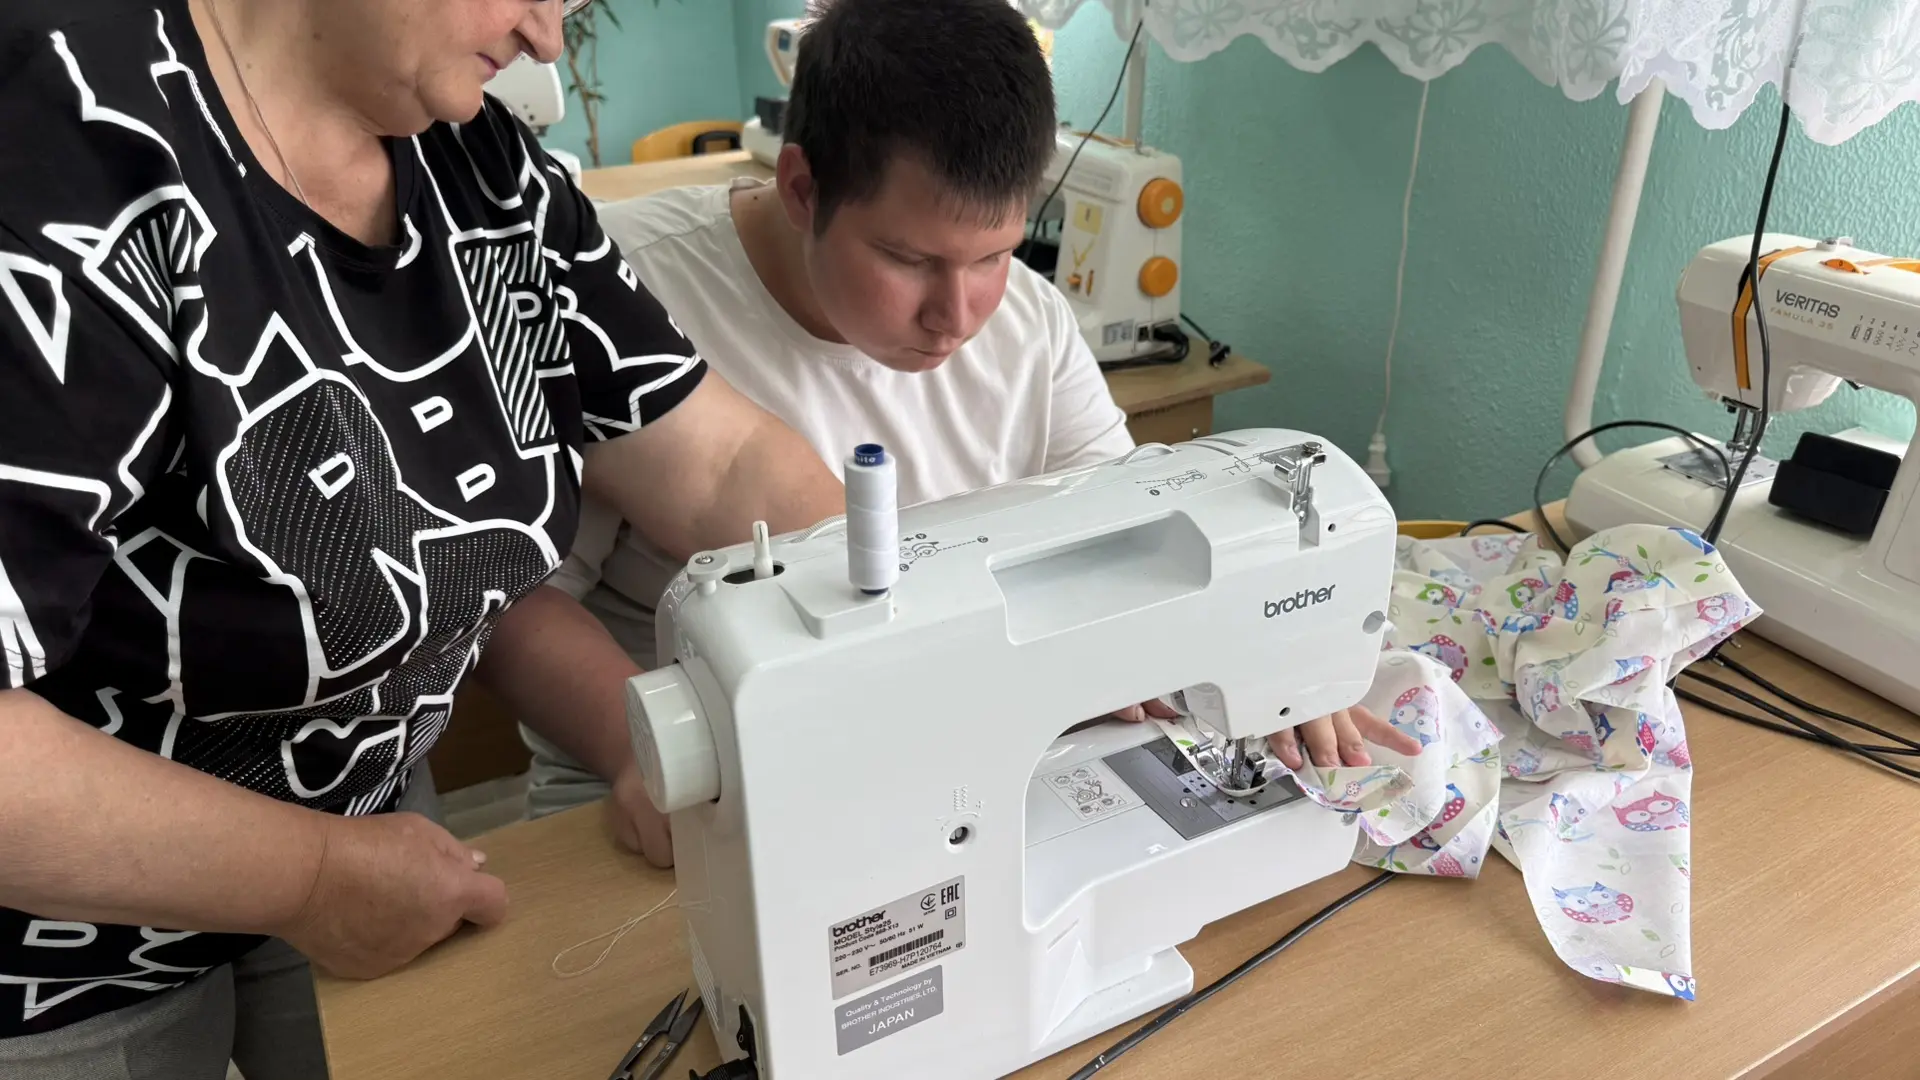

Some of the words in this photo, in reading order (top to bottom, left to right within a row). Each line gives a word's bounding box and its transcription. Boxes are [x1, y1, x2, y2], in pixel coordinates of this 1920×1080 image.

[1776, 289, 1840, 318] VERITAS
[1264, 584, 1336, 618] brother
[941, 883, 960, 906] EAC
[833, 910, 886, 937] brother
[834, 931, 863, 946] MODEL
[834, 940, 858, 952] Product
[859, 933, 874, 942] Code
[901, 959, 918, 969] MADE
[927, 945, 951, 958] VIETNAM
[845, 1003, 872, 1017] Quality
[880, 982, 922, 1002] Technology
[924, 978, 932, 986] by
[841, 1010, 877, 1030] BROTHER
[868, 1008, 914, 1035] JAPAN
